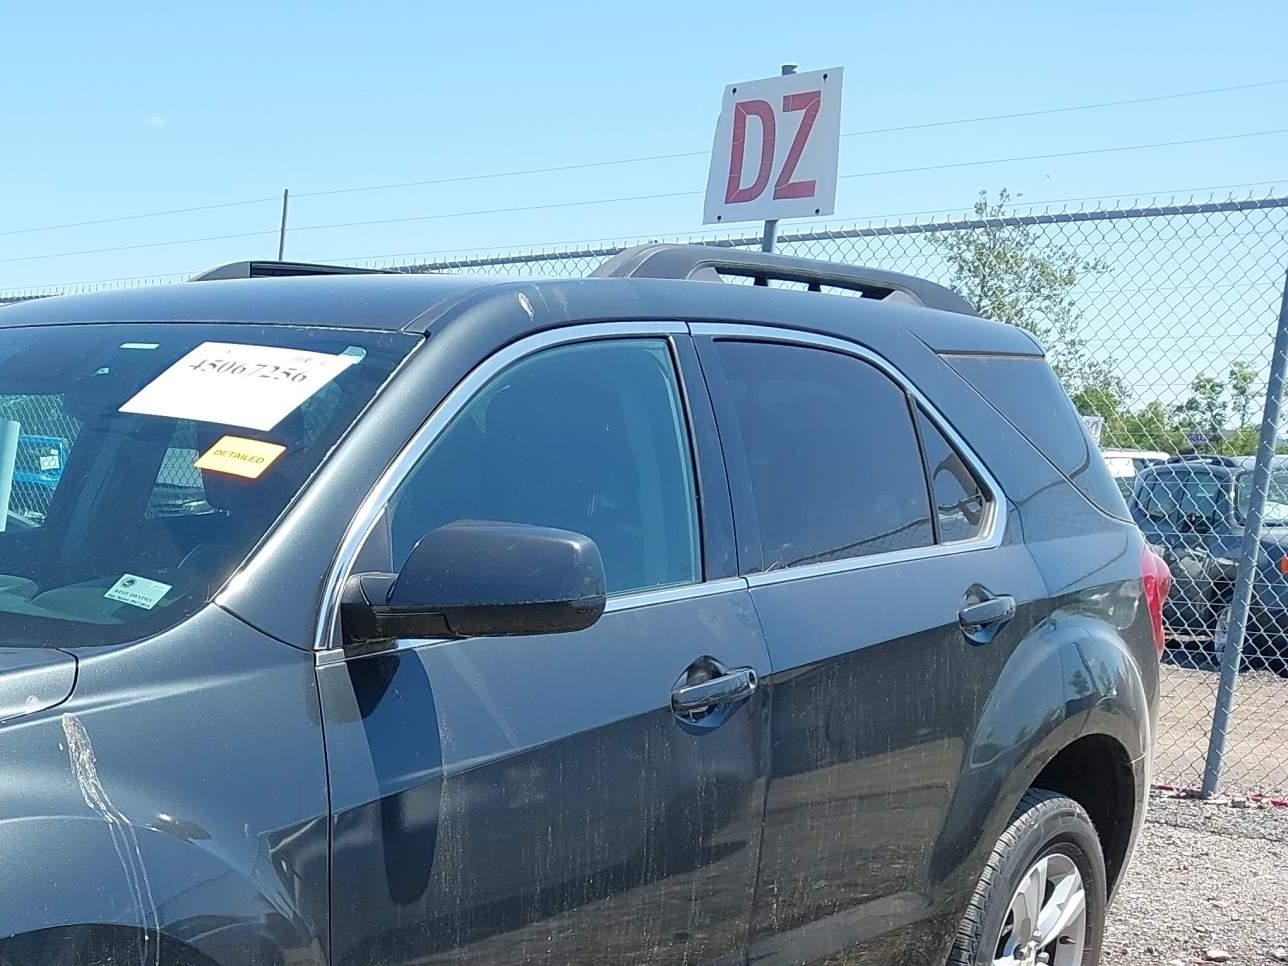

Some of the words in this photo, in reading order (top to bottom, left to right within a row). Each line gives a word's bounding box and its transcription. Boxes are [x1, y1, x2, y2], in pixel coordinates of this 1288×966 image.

[724, 90, 821, 205] DZ
[189, 358, 308, 384] 45067256
[213, 448, 266, 465] DETAILED
